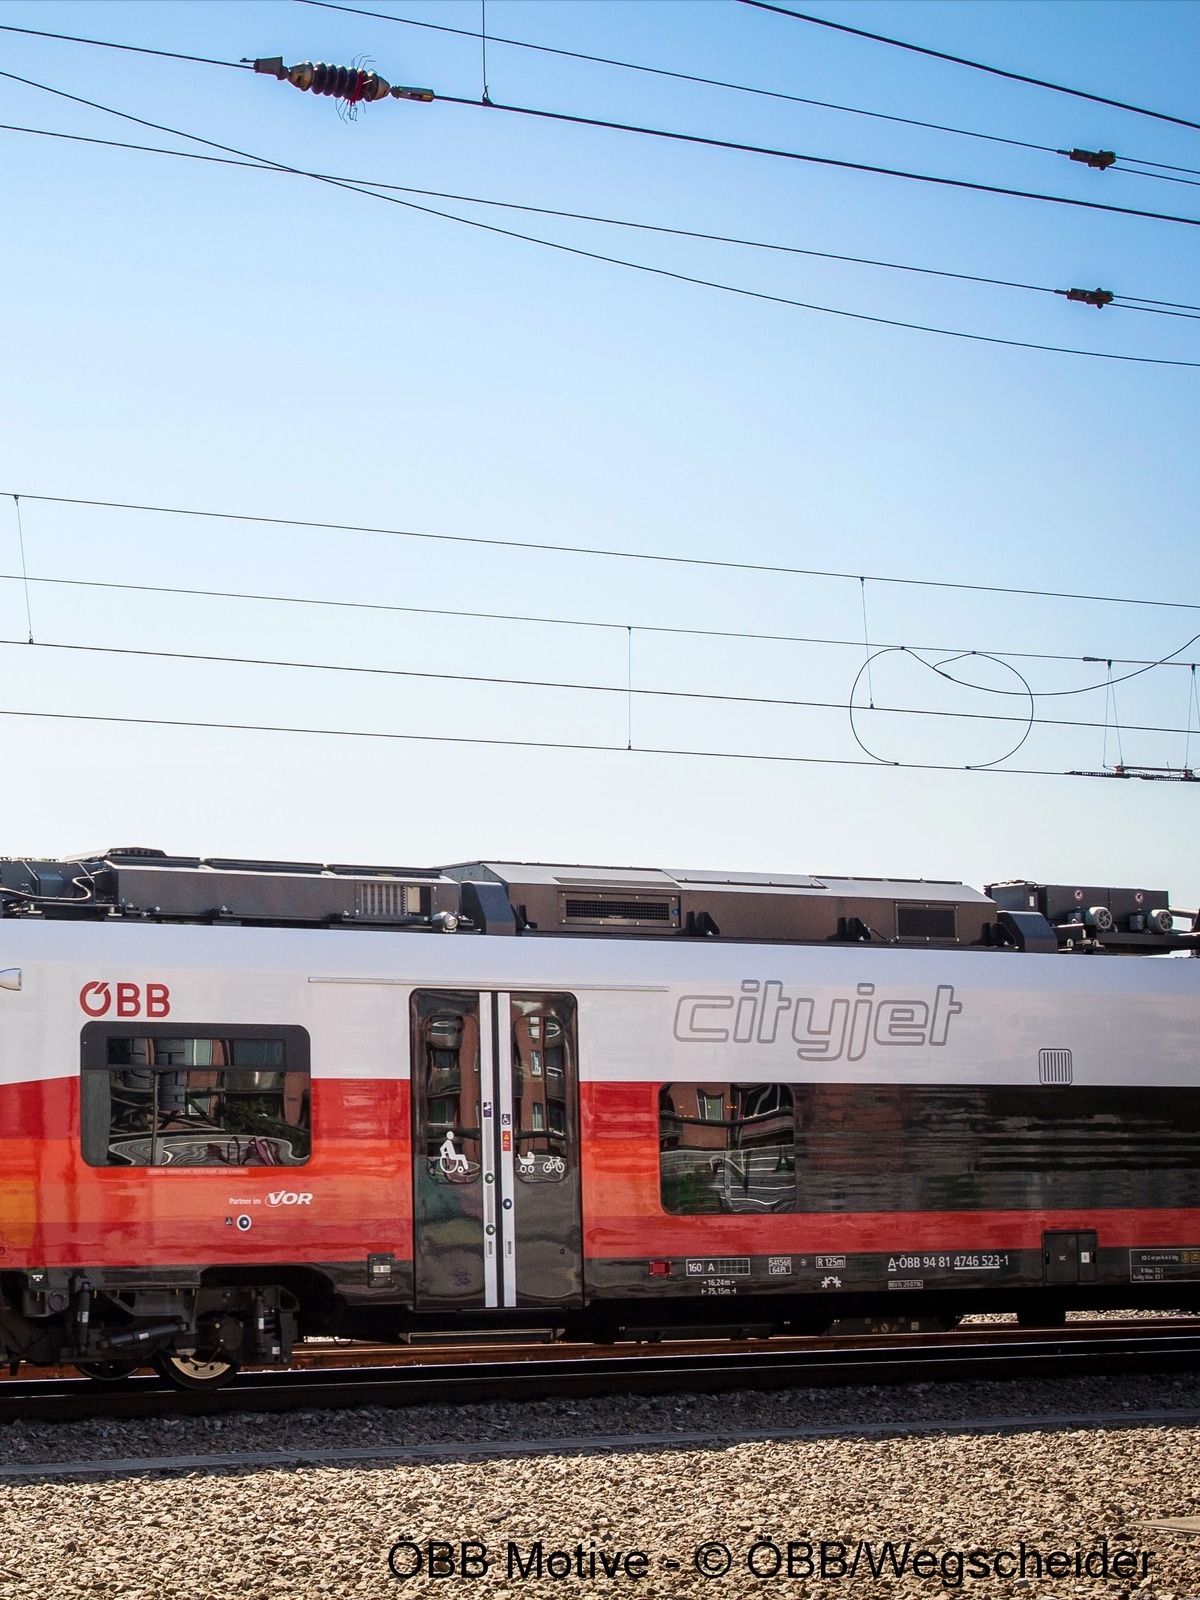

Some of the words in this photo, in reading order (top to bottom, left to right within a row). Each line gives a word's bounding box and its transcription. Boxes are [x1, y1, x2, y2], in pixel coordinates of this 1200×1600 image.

[80, 981, 170, 1017] ÖBB
[673, 980, 962, 1061] cityjet
[229, 1197, 251, 1205] Partner
[268, 1190, 313, 1205] VOR
[688, 1263, 702, 1272] 160
[708, 1263, 715, 1272] A
[818, 1259, 824, 1267] R
[826, 1258, 844, 1267] 125m
[888, 1254, 920, 1269] A-ÖBB
[923, 1257, 936, 1267] 94
[938, 1256, 950, 1267] 81
[954, 1256, 979, 1267] 4746
[982, 1255, 1009, 1266] 523-1
